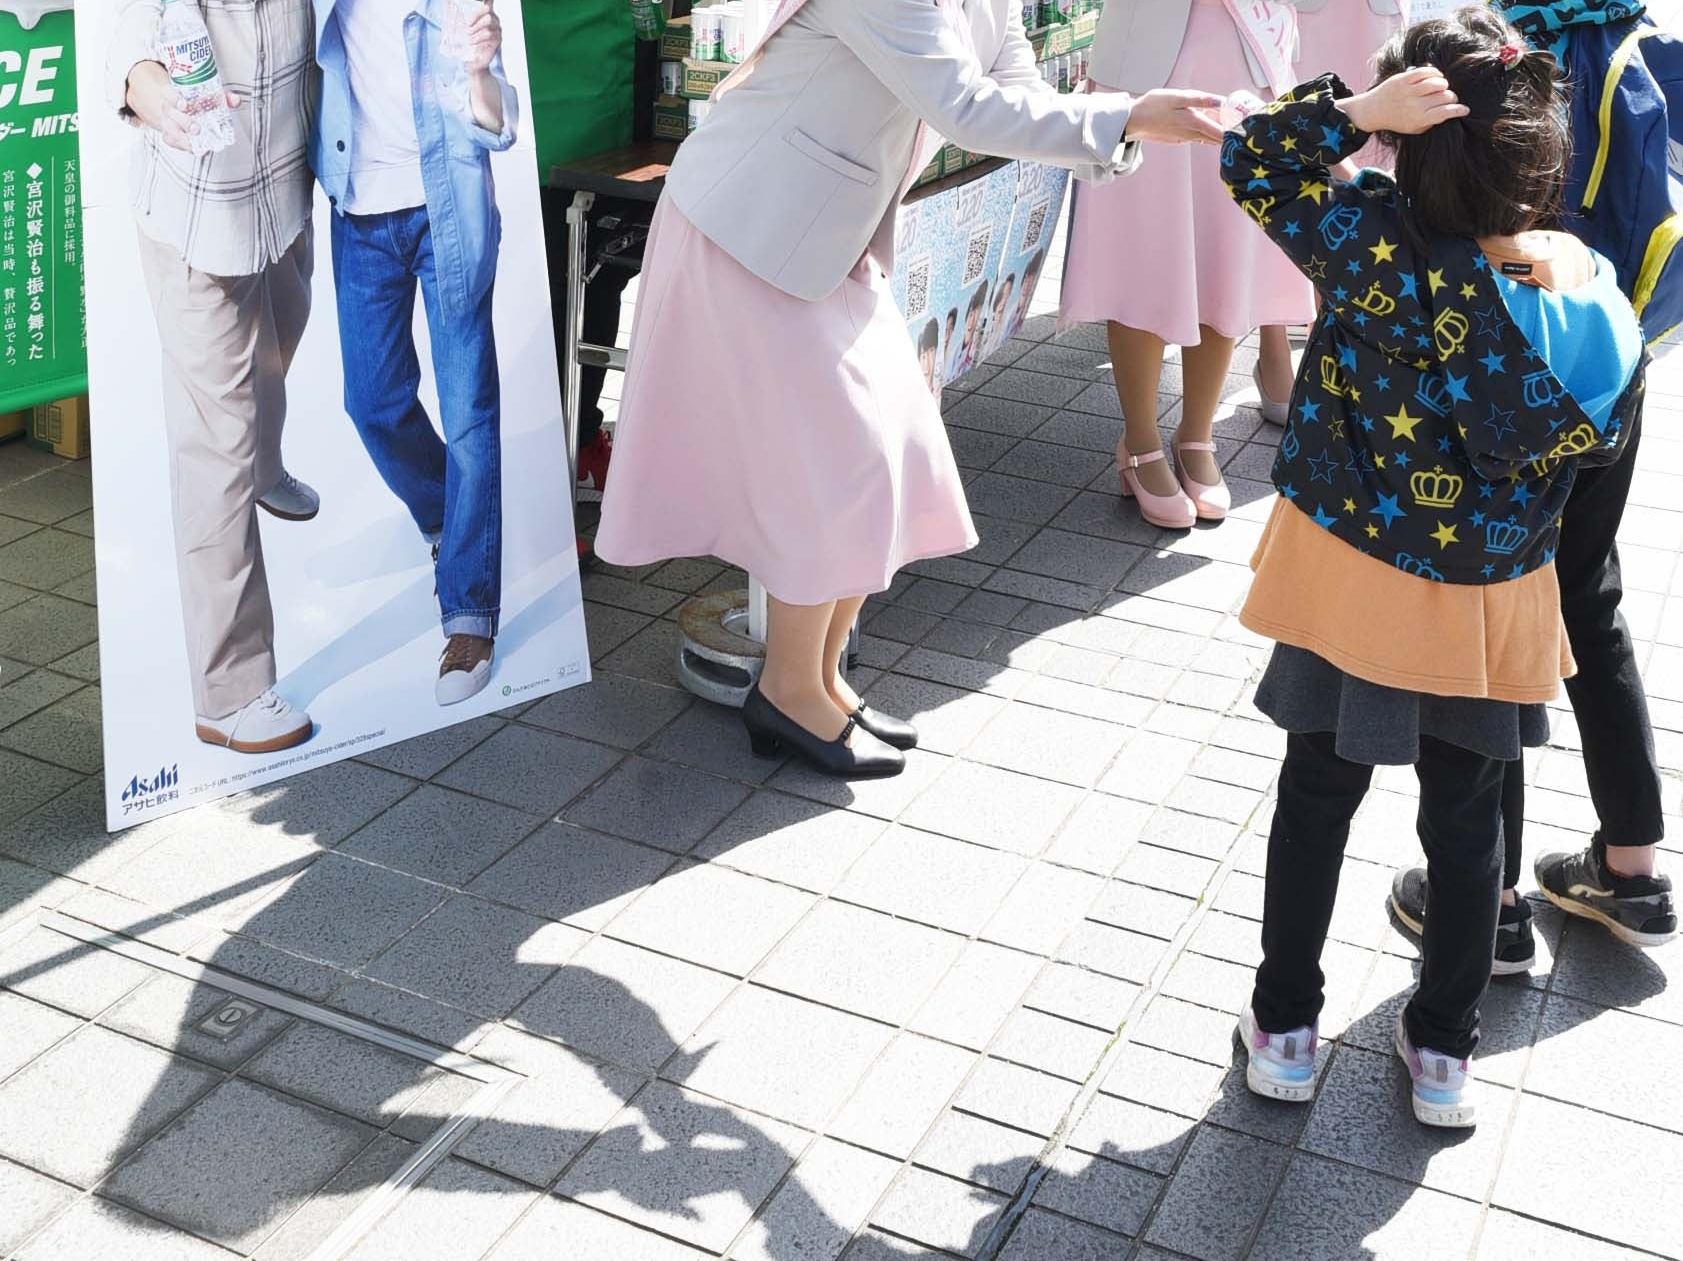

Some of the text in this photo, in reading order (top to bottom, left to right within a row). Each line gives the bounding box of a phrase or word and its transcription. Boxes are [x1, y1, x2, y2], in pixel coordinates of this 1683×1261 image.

[121, 763, 178, 802] Asahi
[122, 789, 180, 816] アサヒ飲料
